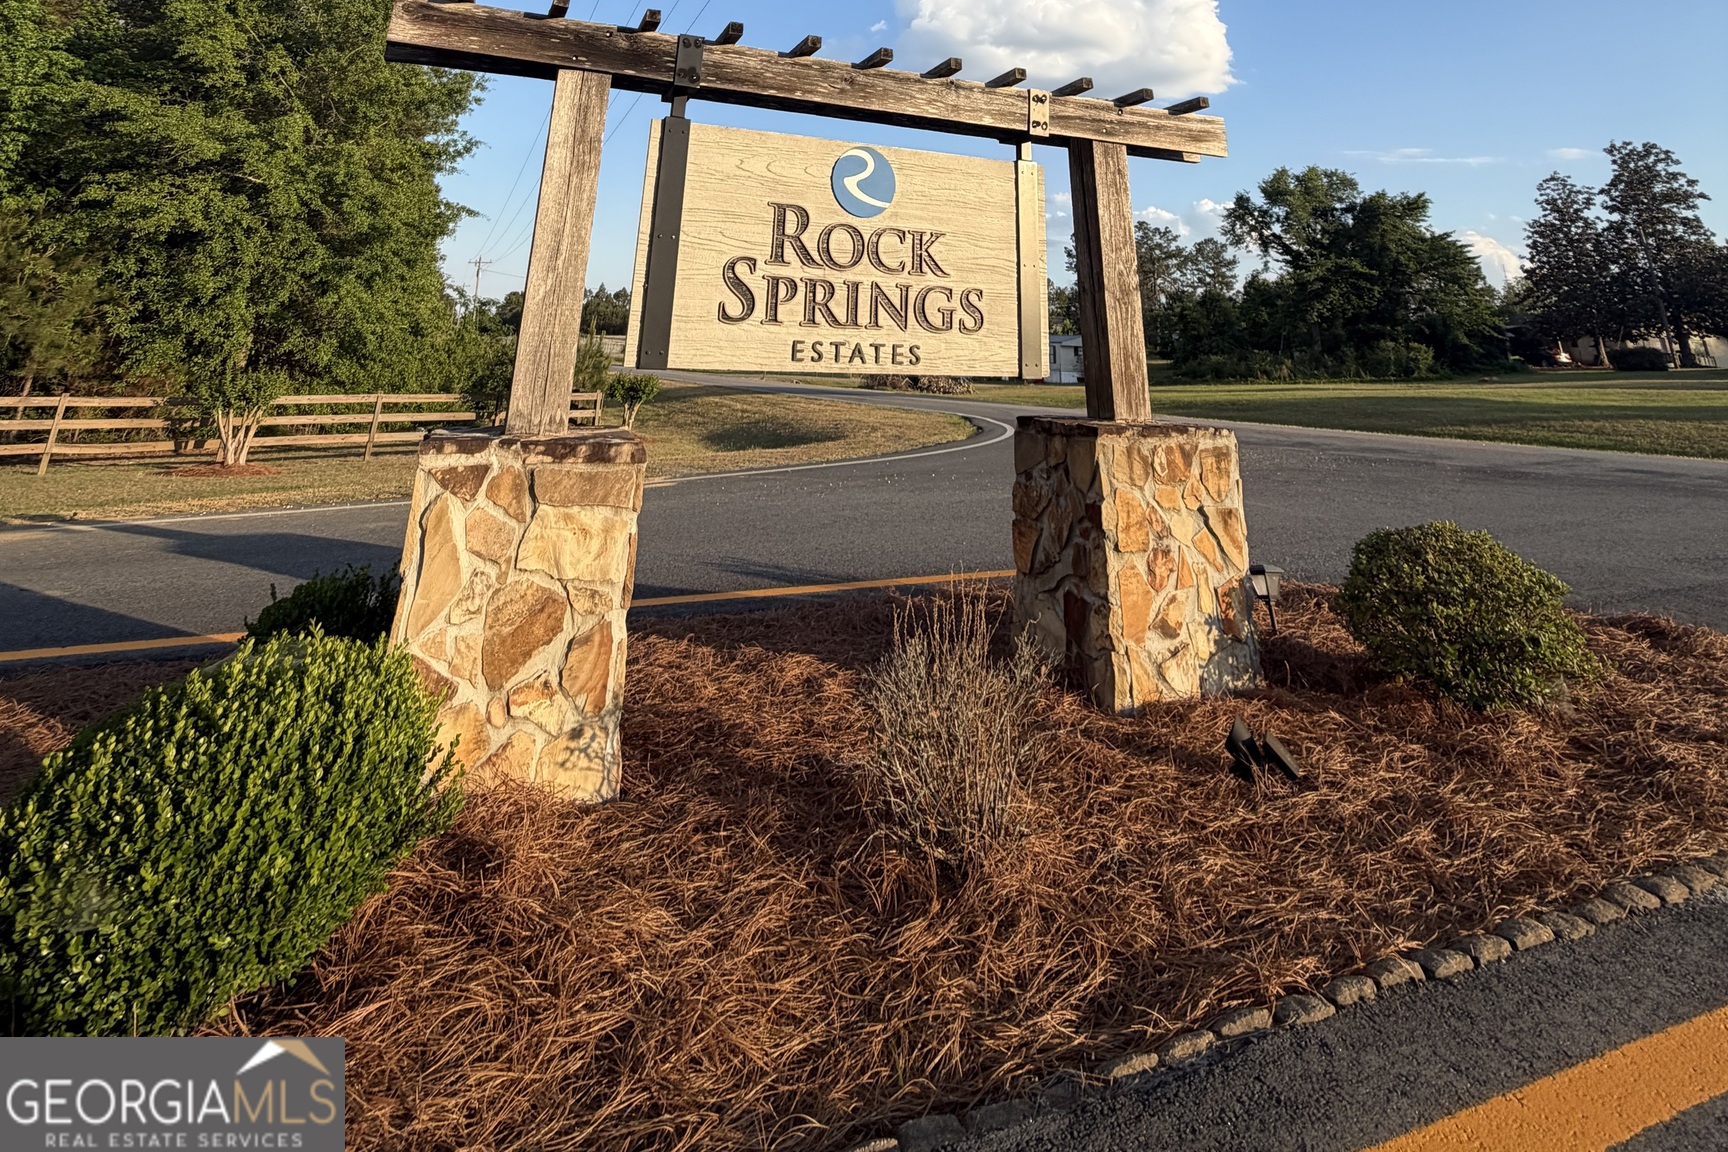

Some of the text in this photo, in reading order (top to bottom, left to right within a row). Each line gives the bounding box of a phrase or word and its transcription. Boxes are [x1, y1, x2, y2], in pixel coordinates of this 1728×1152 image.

[765, 201, 950, 278] ROCK
[717, 255, 985, 334] SPRINGS
[790, 339, 922, 366] ESTATES
